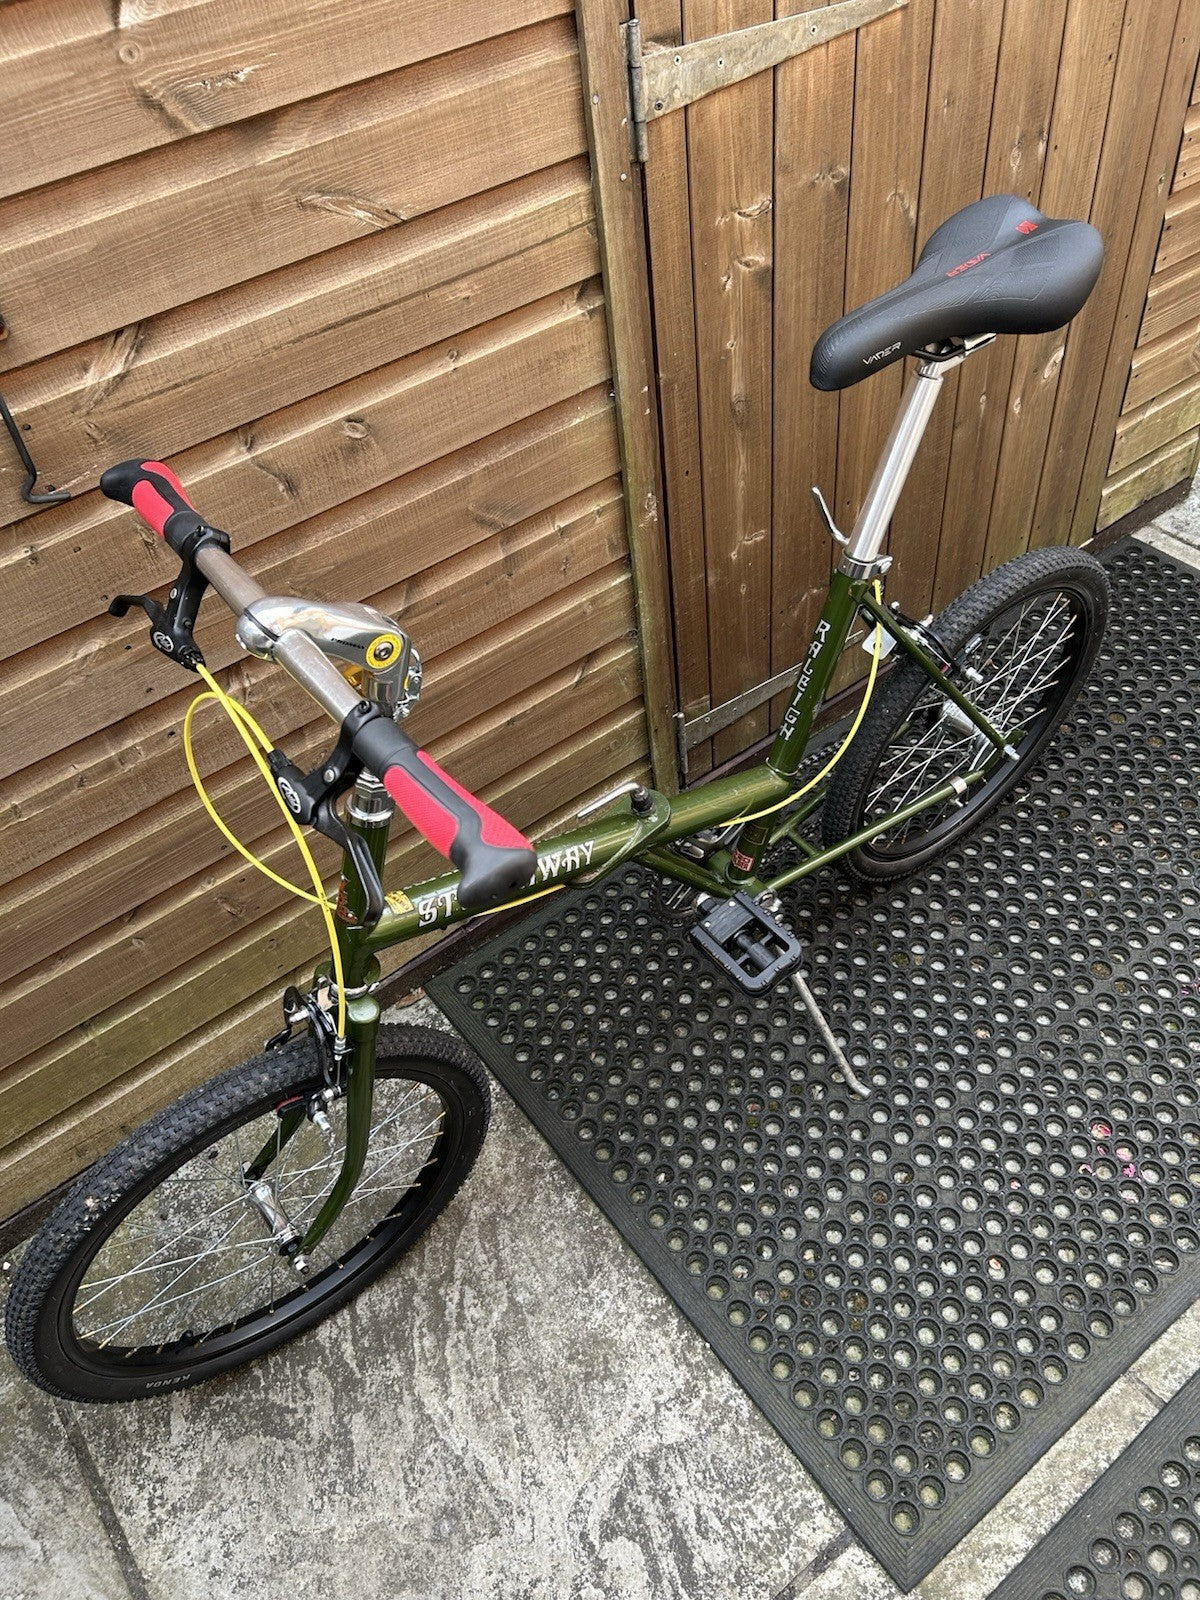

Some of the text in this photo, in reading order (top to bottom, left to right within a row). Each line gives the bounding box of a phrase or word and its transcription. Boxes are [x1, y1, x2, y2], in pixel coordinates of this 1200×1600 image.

[862, 341, 902, 365] VADER
[780, 619, 831, 741] RALEIGH
[418, 840, 595, 928] STWAY
[146, 1373, 191, 1389] KENDA
